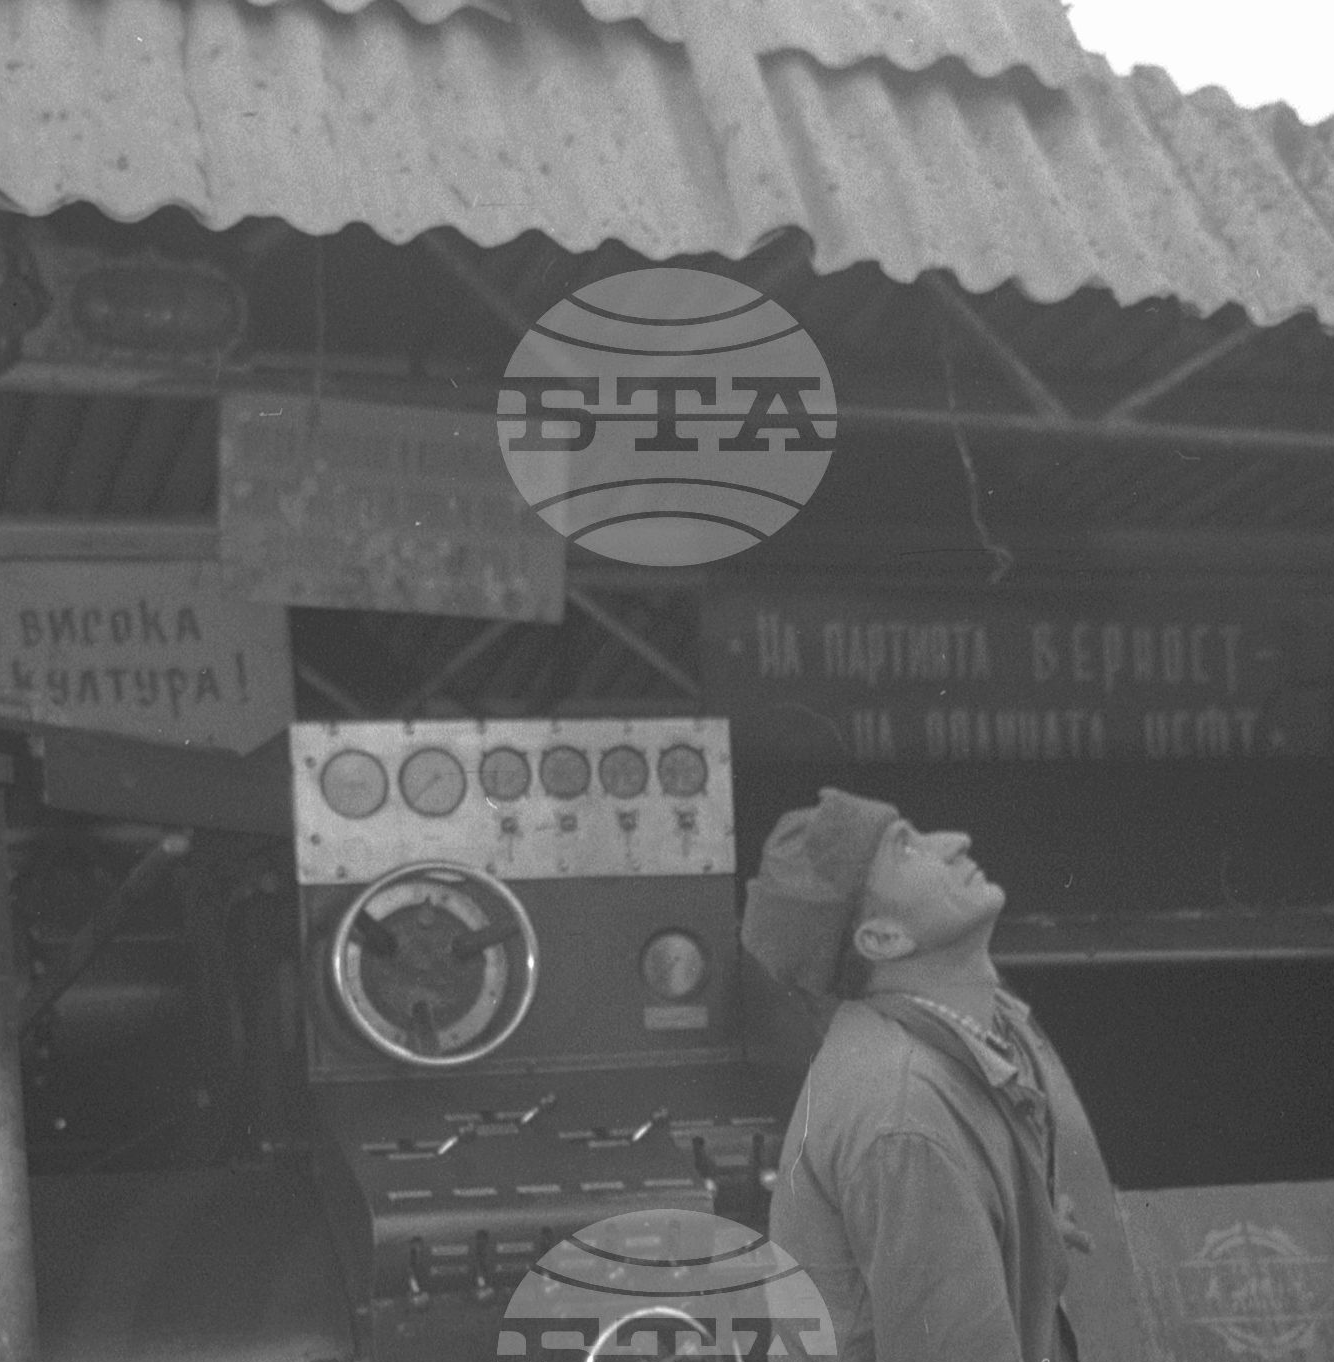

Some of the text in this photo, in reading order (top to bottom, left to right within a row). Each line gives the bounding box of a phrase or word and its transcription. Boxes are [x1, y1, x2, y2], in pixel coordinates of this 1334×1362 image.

[19, 598, 203, 648] ВИСОКА
[755, 610, 804, 680] НА
[823, 619, 992, 687] ПАРТИЯТА
[1031, 621, 1244, 695] ВЕРНОСТ
